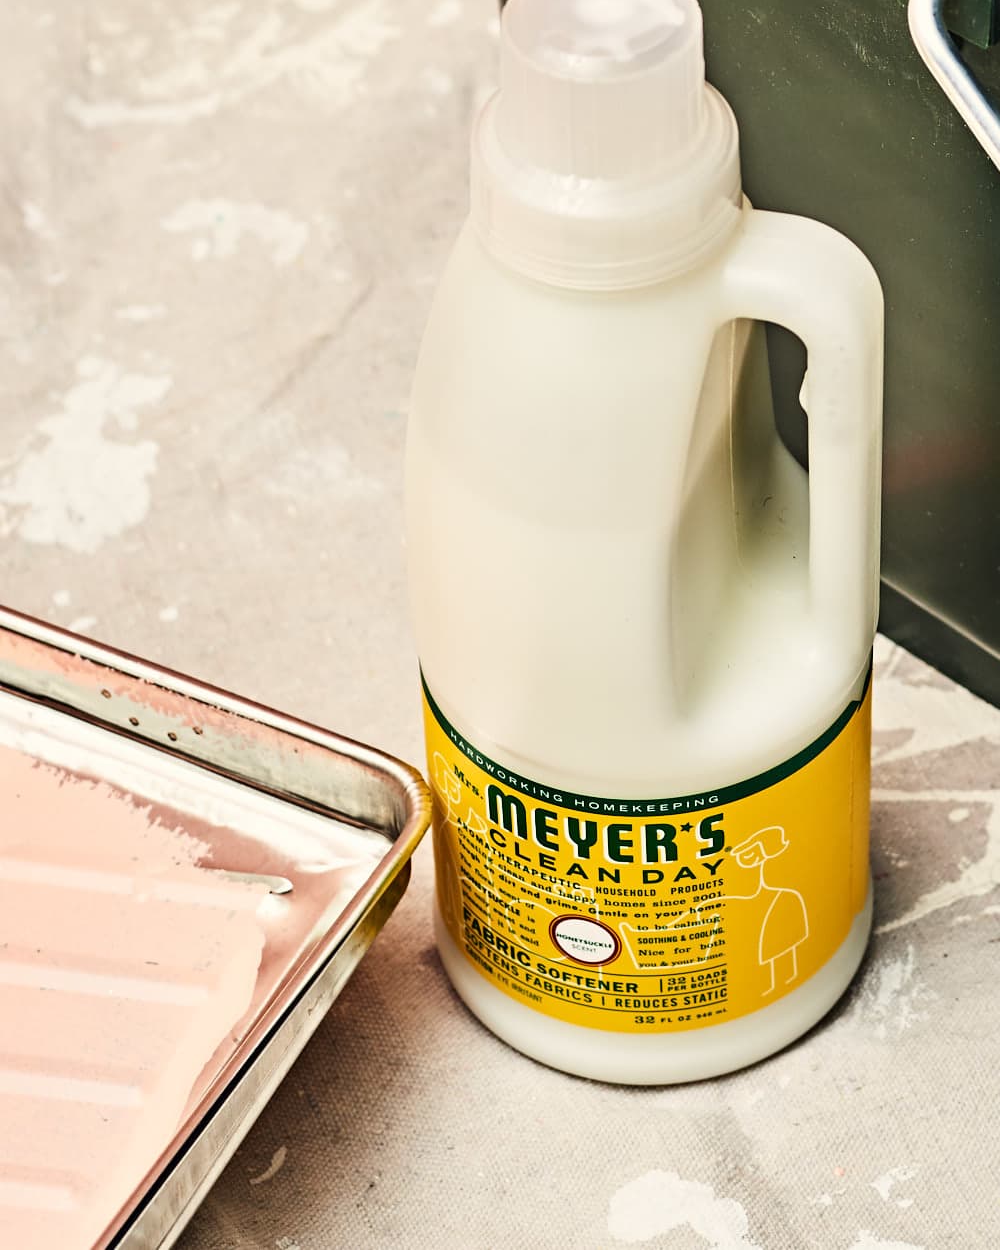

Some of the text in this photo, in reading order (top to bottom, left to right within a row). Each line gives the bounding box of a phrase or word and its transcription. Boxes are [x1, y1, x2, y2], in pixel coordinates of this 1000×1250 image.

[450, 731, 719, 812] HARDWORKING HOMEKEEPING
[454, 765, 484, 800] Mrs.
[457, 817, 724, 897] AROMATHERAPEUTIC HOUSEHOLD PRODUCTS
[489, 828, 724, 884] CLEAN DAY
[458, 827, 726, 907] Creating clean and happy homes since 2001.
[460, 866, 521, 916] HONEYSUCKLE
[498, 874, 516, 887] dirt
[520, 886, 540, 899] and
[545, 897, 582, 912] grime.
[588, 907, 628, 918] Gentle
[655, 910, 684, 919] your
[689, 902, 726, 914] home.
[525, 902, 535, 910] of
[519, 920, 536, 934] and
[674, 915, 725, 930] calming.
[556, 933, 613, 949] HONEYSUCKLE
[570, 943, 597, 953] SCENT
[637, 936, 678, 945] SOOTHING
[674, 947, 692, 955] for
[700, 939, 726, 951] both
[463, 907, 639, 993] FABRIC SOFTENER
[464, 926, 728, 1009] SOFTENS FABRICS REDUCES STATIC
[671, 957, 695, 967] your
[697, 952, 726, 963] home.
[666, 968, 728, 985] 32 LOADS
[690, 975, 728, 988] BOTTLE
[635, 1015, 656, 1023] 32
